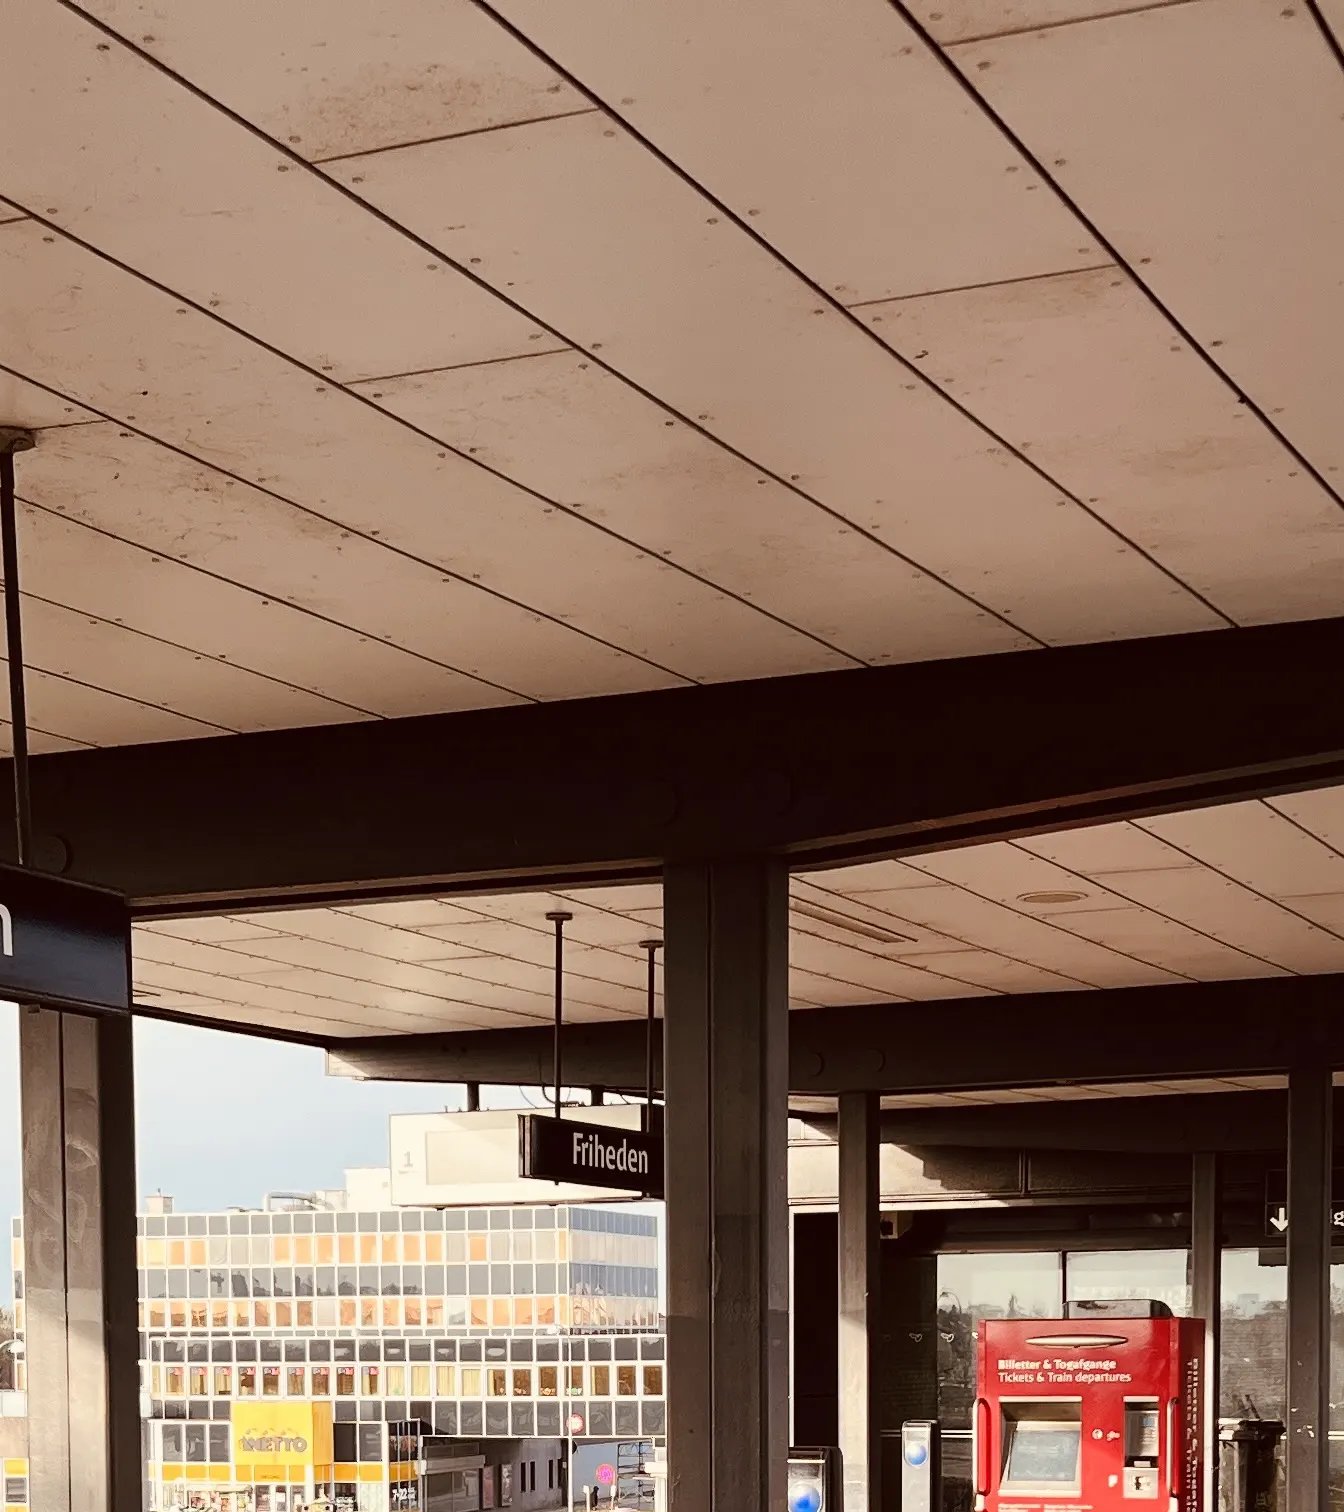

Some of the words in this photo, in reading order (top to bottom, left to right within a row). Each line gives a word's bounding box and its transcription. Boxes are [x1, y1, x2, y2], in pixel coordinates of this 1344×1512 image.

[573, 1132, 649, 1174] Friheden
[1043, 1359, 1052, 1370] &
[998, 1371, 1034, 1383] Tickets
[1036, 1372, 1045, 1383] &
[1047, 1371, 1073, 1383] Train
[1075, 1371, 1132, 1385] departures
[241, 1436, 308, 1453] NETTO
